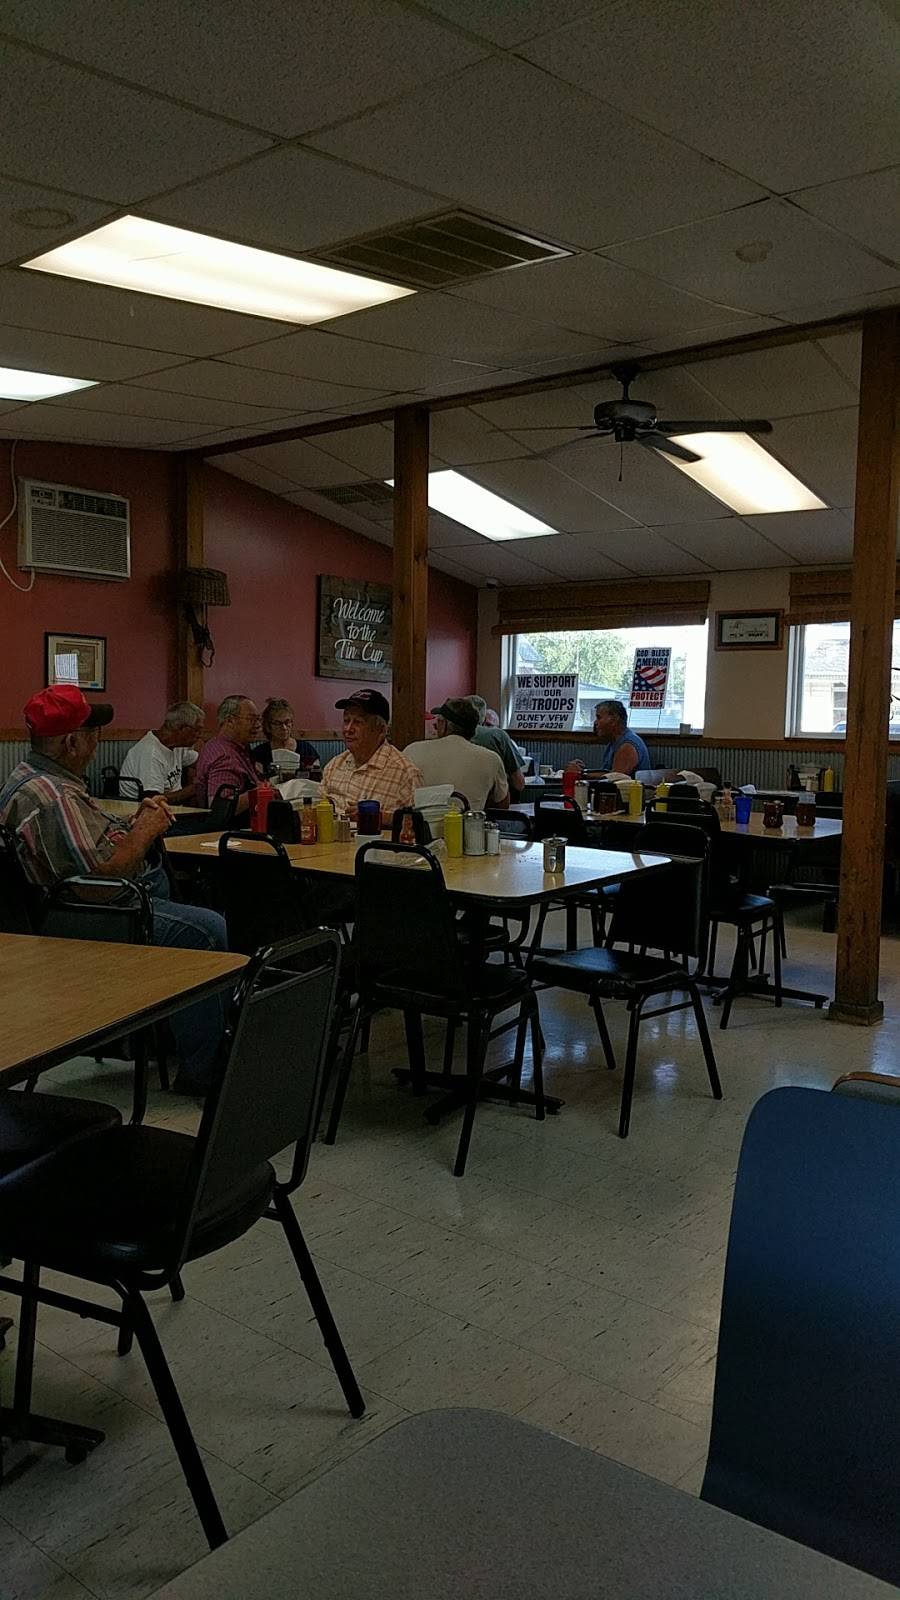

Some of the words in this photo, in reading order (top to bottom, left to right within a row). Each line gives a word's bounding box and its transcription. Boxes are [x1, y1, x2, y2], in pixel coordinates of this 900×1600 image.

[333, 597, 385, 623] Welcome
[347, 621, 360, 640] to
[360, 623, 377, 641] the
[334, 639, 357, 660] Tin
[362, 641, 384, 668] Cup
[636, 649, 649, 657] GOD
[652, 649, 670, 657] BLESS
[635, 657, 668, 667] AMERICA
[517, 676, 532, 689] WE
[533, 675, 576, 688] SUPPORT
[543, 689, 562, 697] OUR
[630, 692, 665, 701] PROTECT
[532, 697, 575, 711] TROOPS
[516, 713, 546, 722] OLNEY
[548, 713, 569, 722] VFW
[517, 721, 539, 729] POST
